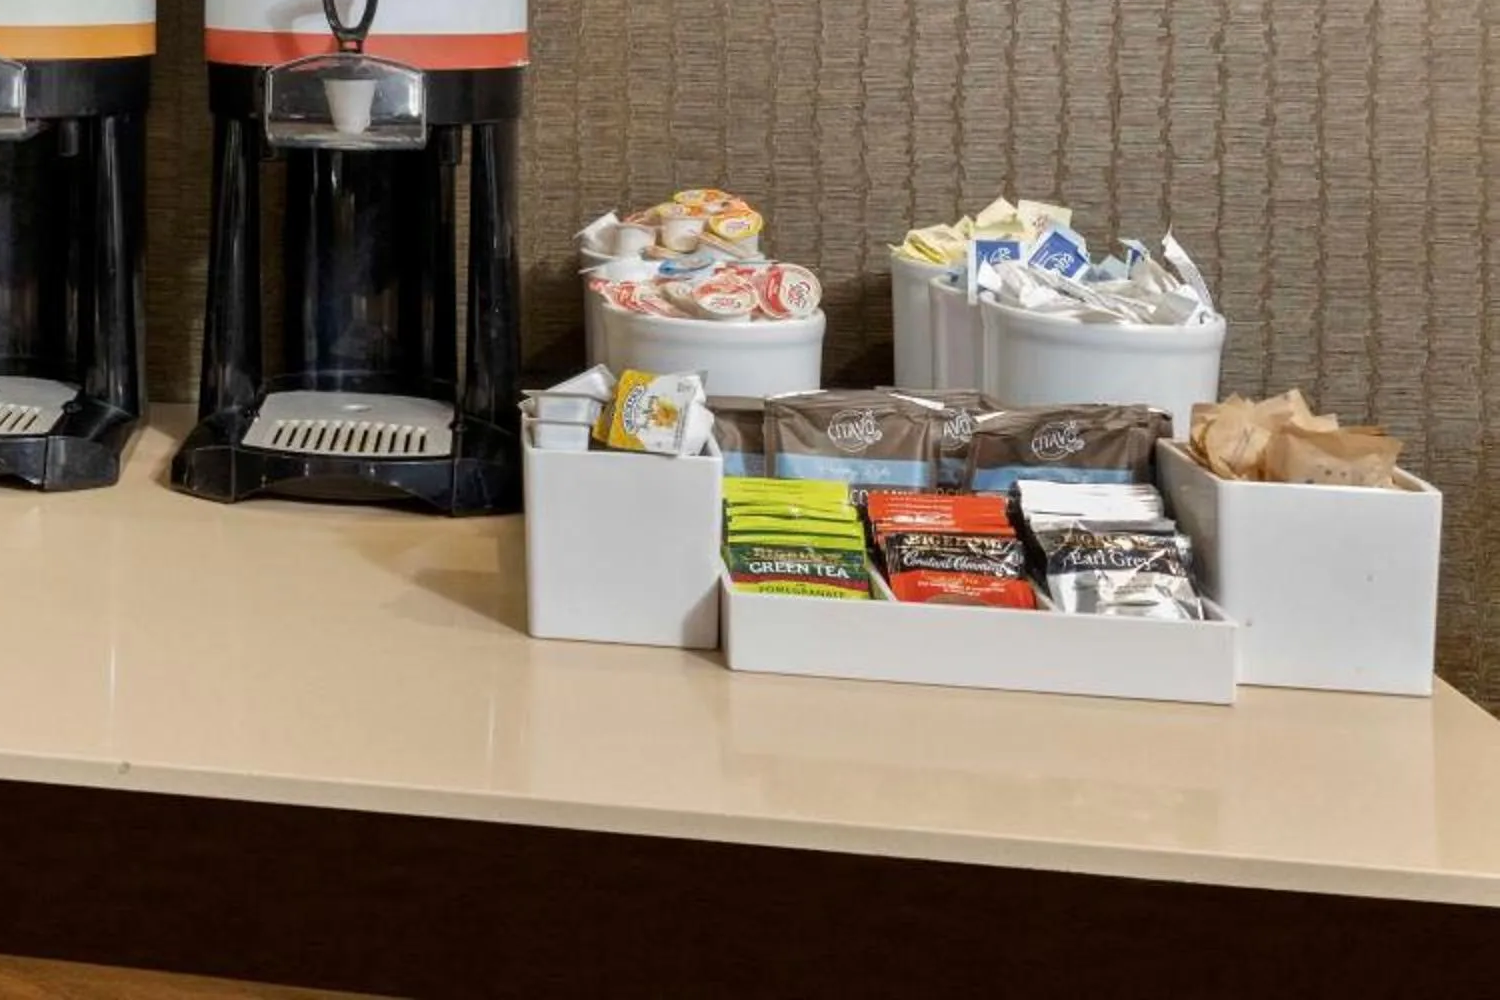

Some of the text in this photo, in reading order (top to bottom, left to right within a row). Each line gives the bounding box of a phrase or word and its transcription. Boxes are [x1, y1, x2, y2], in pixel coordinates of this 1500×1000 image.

[749, 560, 851, 580] GREEN TEA
[1109, 549, 1154, 571] Grey
